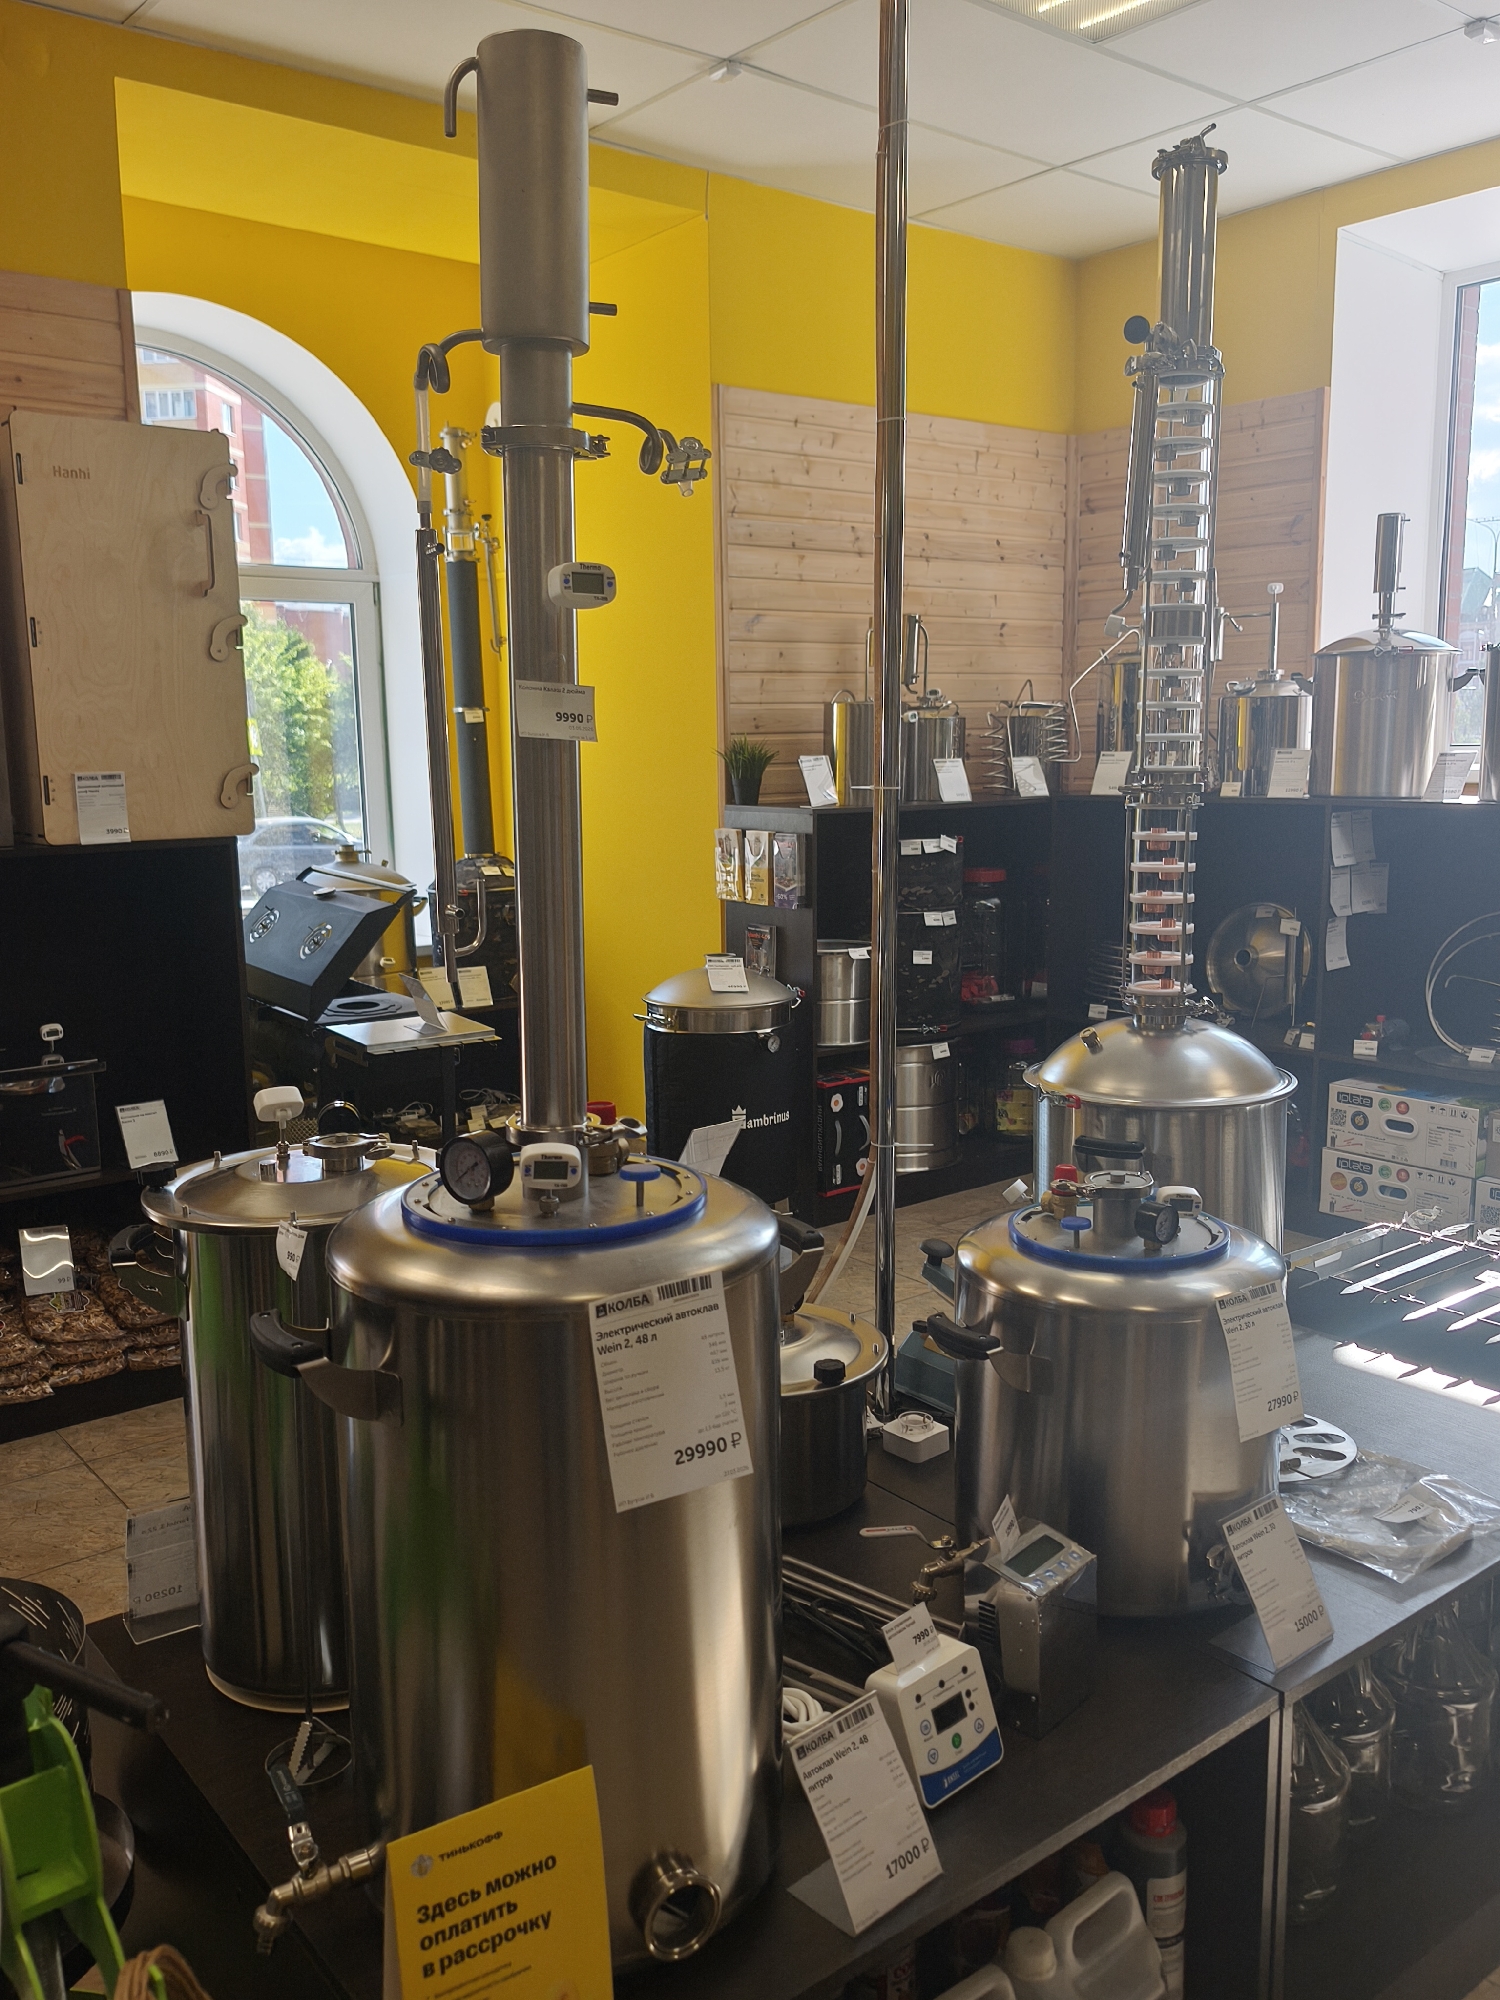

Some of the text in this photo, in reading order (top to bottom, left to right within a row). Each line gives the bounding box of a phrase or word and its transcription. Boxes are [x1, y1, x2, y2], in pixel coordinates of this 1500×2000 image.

[52, 465, 90, 480] Hanhi
[580, 563, 602, 571] Thermo
[555, 712, 584, 723] 9990
[607, 1293, 650, 1314] КОЛБА
[1225, 1294, 1248, 1307] КОЛБА
[595, 1303, 720, 1341] Электрический автоклав
[1222, 1302, 1284, 1325] Электрический автоклав
[1225, 1325, 1239, 1335] Wein
[597, 1333, 658, 1356] Wein 2, 48 л
[1267, 1393, 1293, 1412] 27990
[673, 1431, 742, 1466] 29990 ₽
[1232, 1516, 1253, 1533] КОЛБА
[1232, 1536, 1253, 1552] Автоклав
[1253, 1529, 1265, 1541] Wein
[1294, 1608, 1319, 1633] 15000
[912, 1628, 930, 1645] 7990
[805, 1730, 834, 1754] КОЛБА
[803, 1734, 869, 1781] Автоклав Wein 2, 48
[807, 1773, 834, 1794] литров
[438, 1831, 503, 1862] ТИНЬКОФФ
[885, 1845, 921, 1880] 17000
[416, 1854, 557, 1925] Здесь можно
[419, 1900, 518, 1951] оплатить
[422, 1909, 552, 1979] в рассрочку
